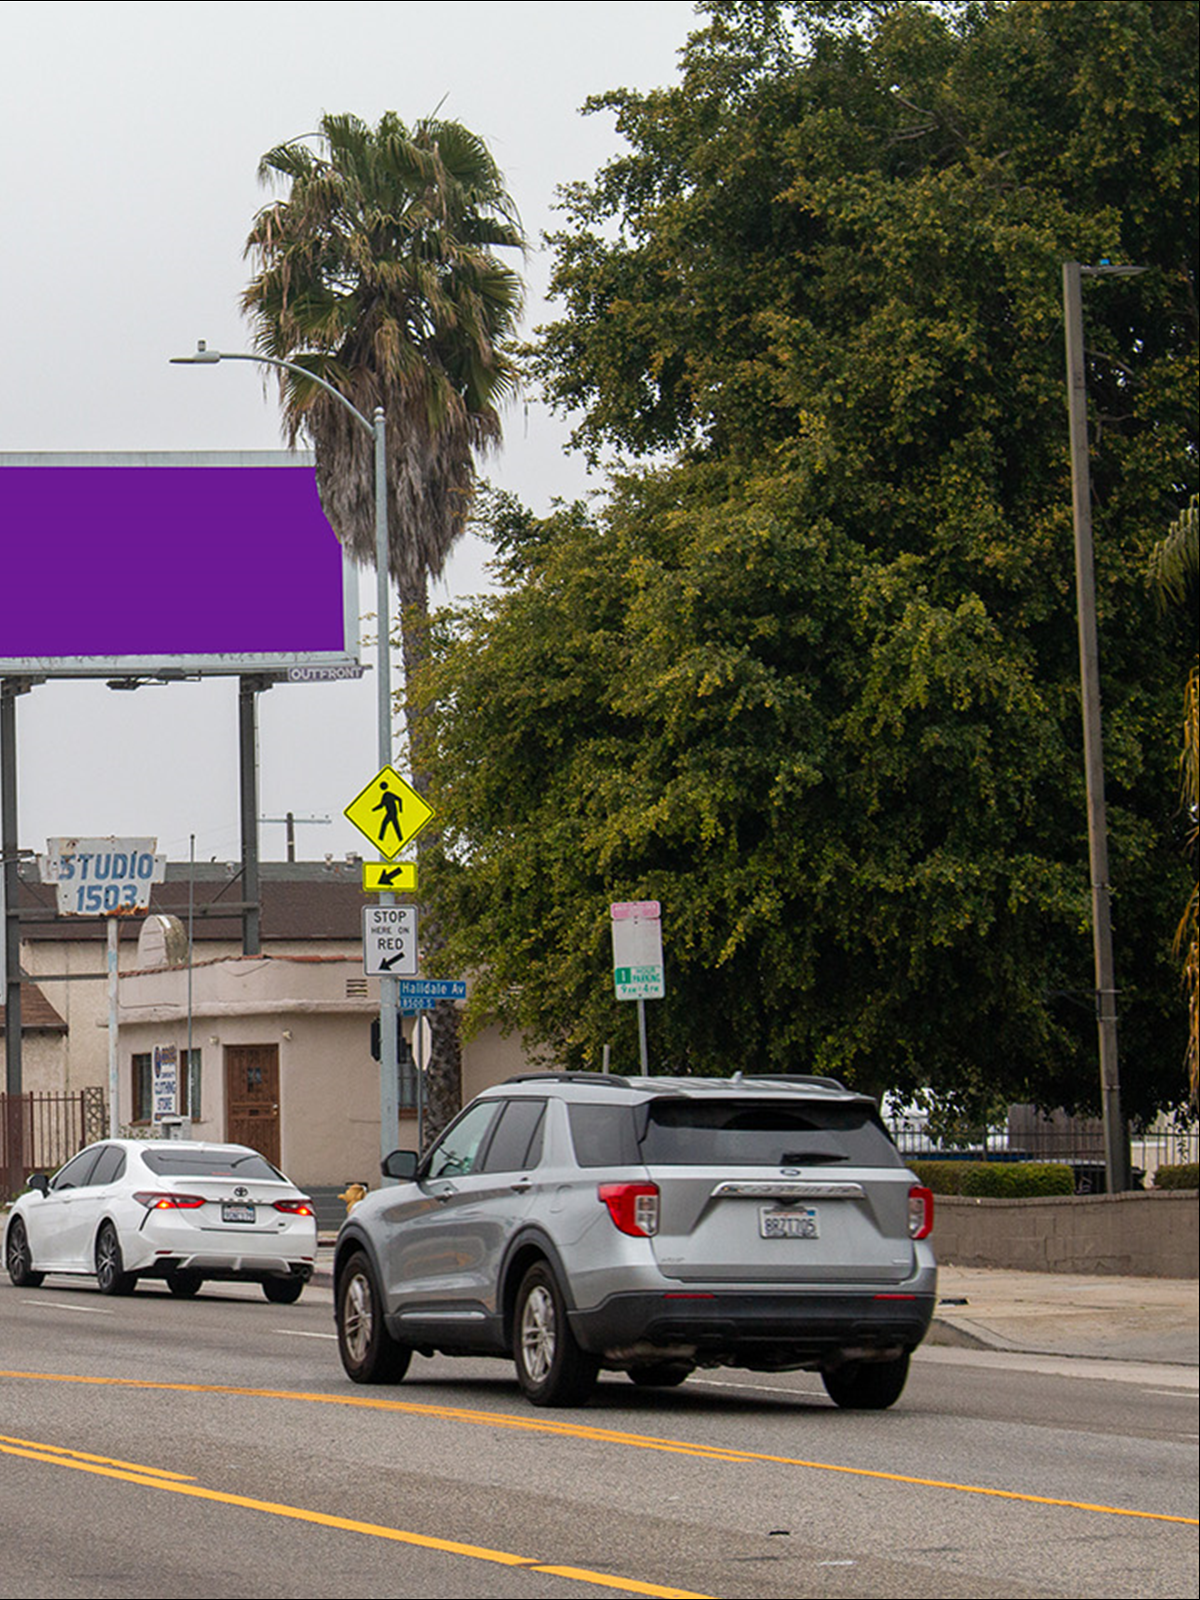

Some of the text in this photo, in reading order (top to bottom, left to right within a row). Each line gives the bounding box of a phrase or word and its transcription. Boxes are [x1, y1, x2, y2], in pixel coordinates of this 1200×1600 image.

[291, 667, 361, 680] OUTFRONT
[58, 853, 154, 880] STUDIO
[76, 884, 138, 912] 1503
[374, 911, 406, 923] STOP
[378, 938, 404, 950] RED
[402, 982, 465, 994] Halldale Av
